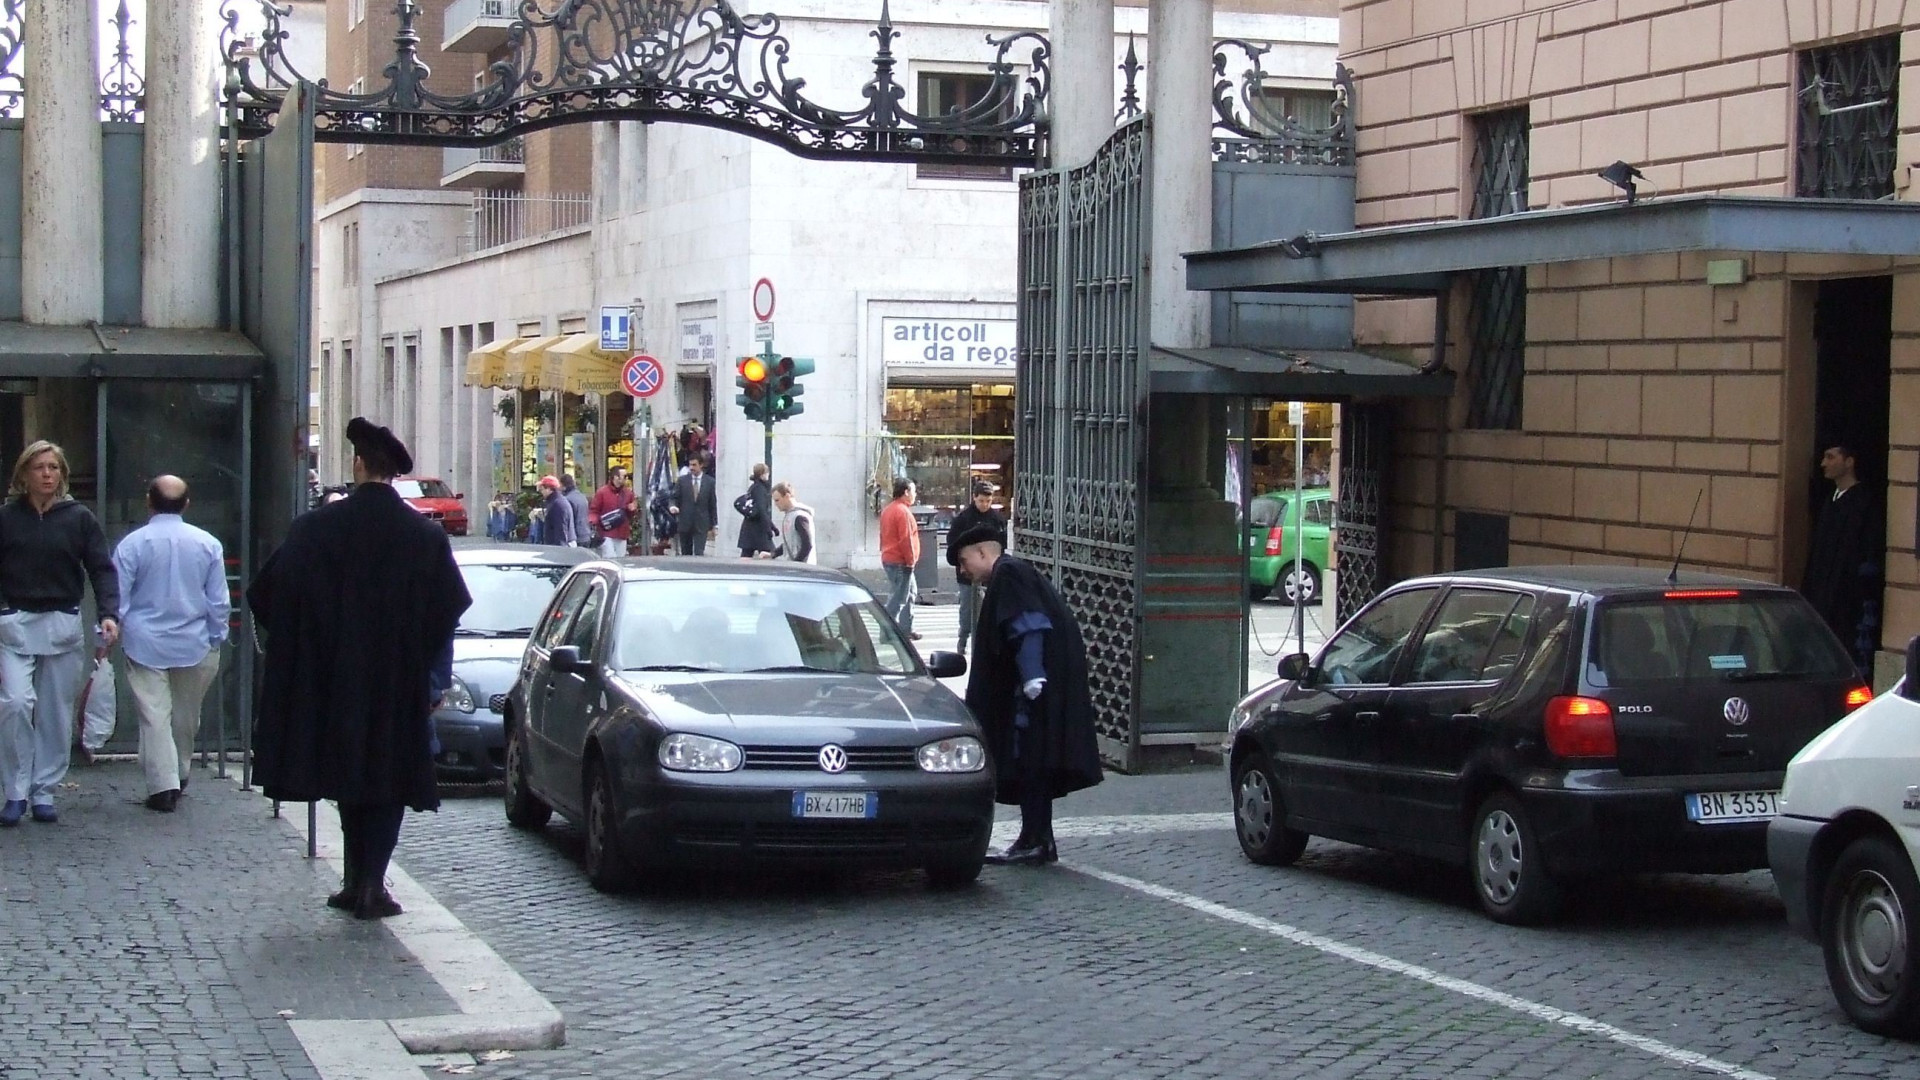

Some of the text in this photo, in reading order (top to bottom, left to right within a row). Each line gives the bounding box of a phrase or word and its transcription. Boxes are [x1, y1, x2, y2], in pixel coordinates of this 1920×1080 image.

[894, 323, 985, 342] articoli
[923, 342, 954, 361] da
[1618, 705, 1652, 713] POLO
